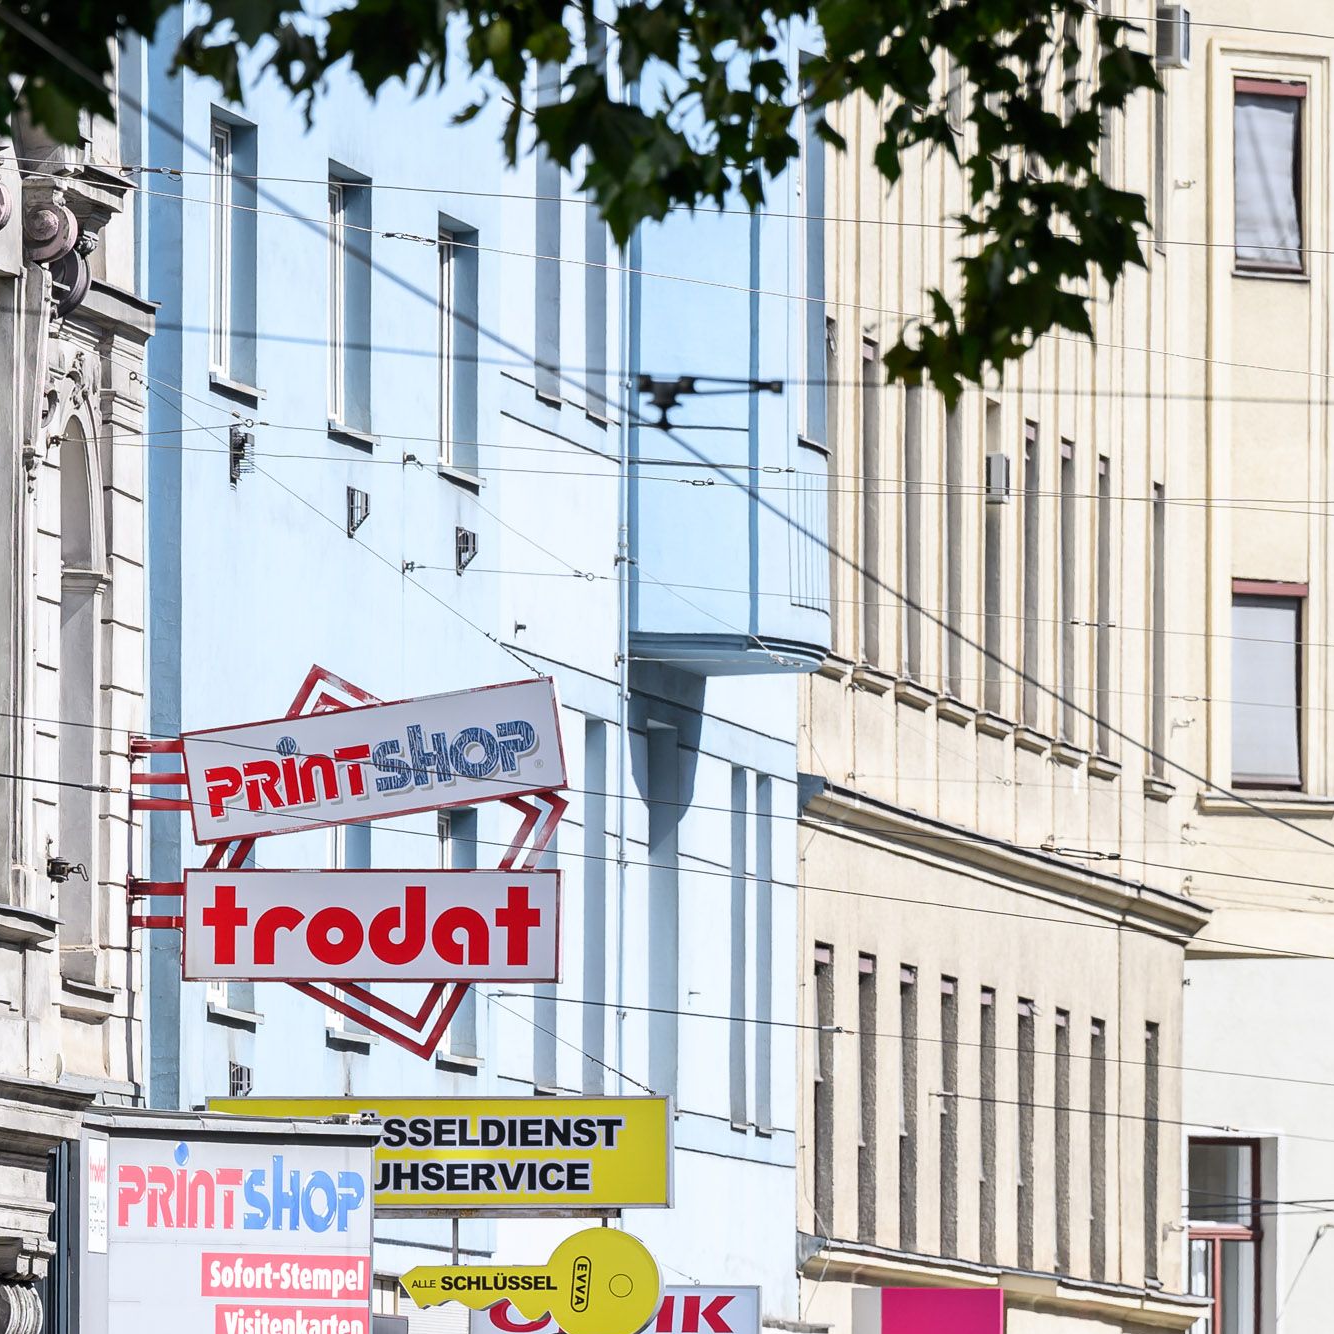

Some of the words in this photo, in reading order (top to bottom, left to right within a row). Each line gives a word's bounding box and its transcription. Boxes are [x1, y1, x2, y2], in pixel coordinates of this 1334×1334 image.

[202, 885, 541, 966] trodat
[379, 1113, 622, 1147] SSELDIENST
[210, 1261, 364, 1298] Sofort-Stempel
[412, 1280, 436, 1289] ALLE
[440, 1272, 557, 1291] SCHLÜSSEL
[574, 1263, 588, 1306] EVVA
